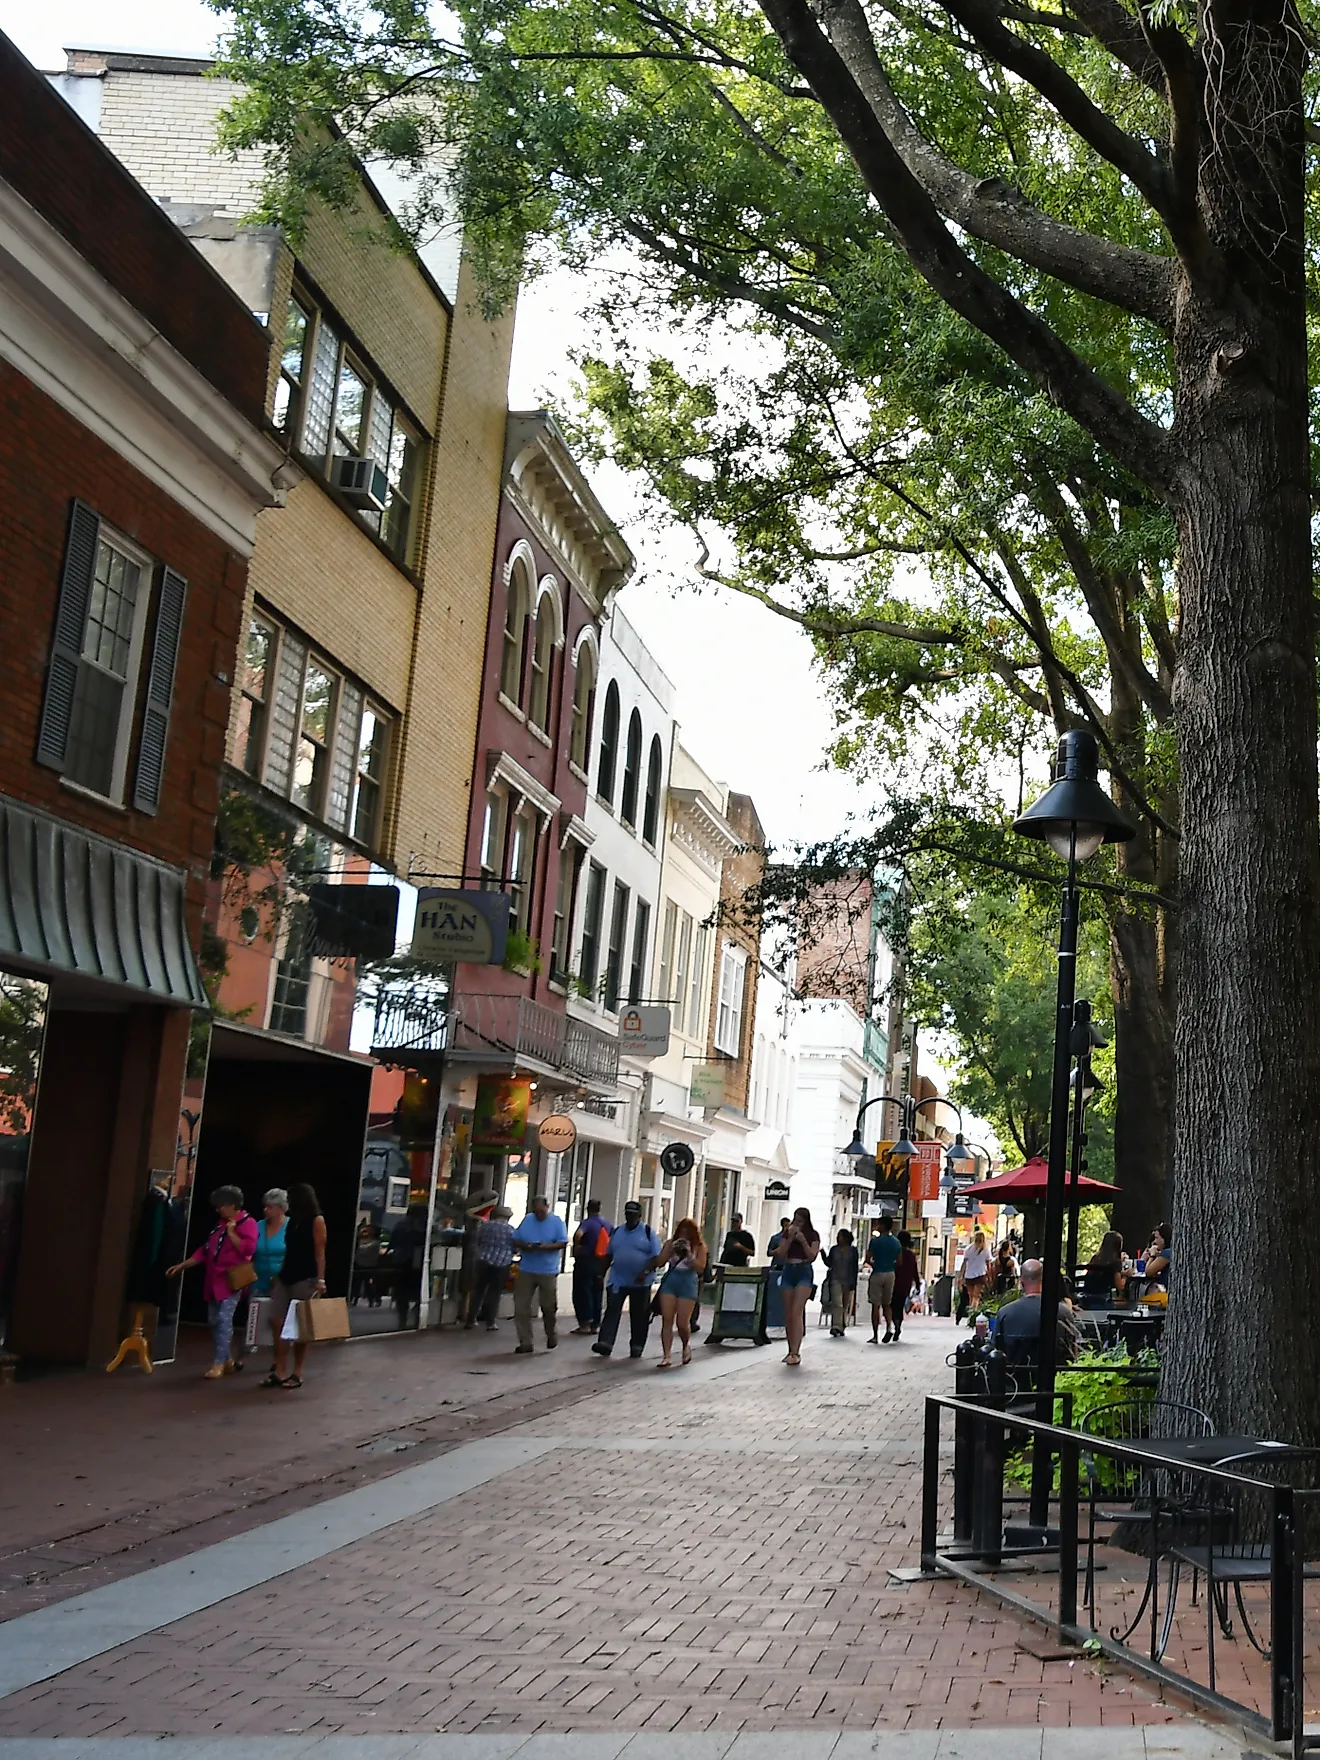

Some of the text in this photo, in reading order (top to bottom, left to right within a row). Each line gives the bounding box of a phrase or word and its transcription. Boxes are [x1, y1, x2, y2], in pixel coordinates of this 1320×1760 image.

[438, 902, 457, 911] The
[421, 911, 477, 930] HAN
[432, 931, 473, 942] Studio
